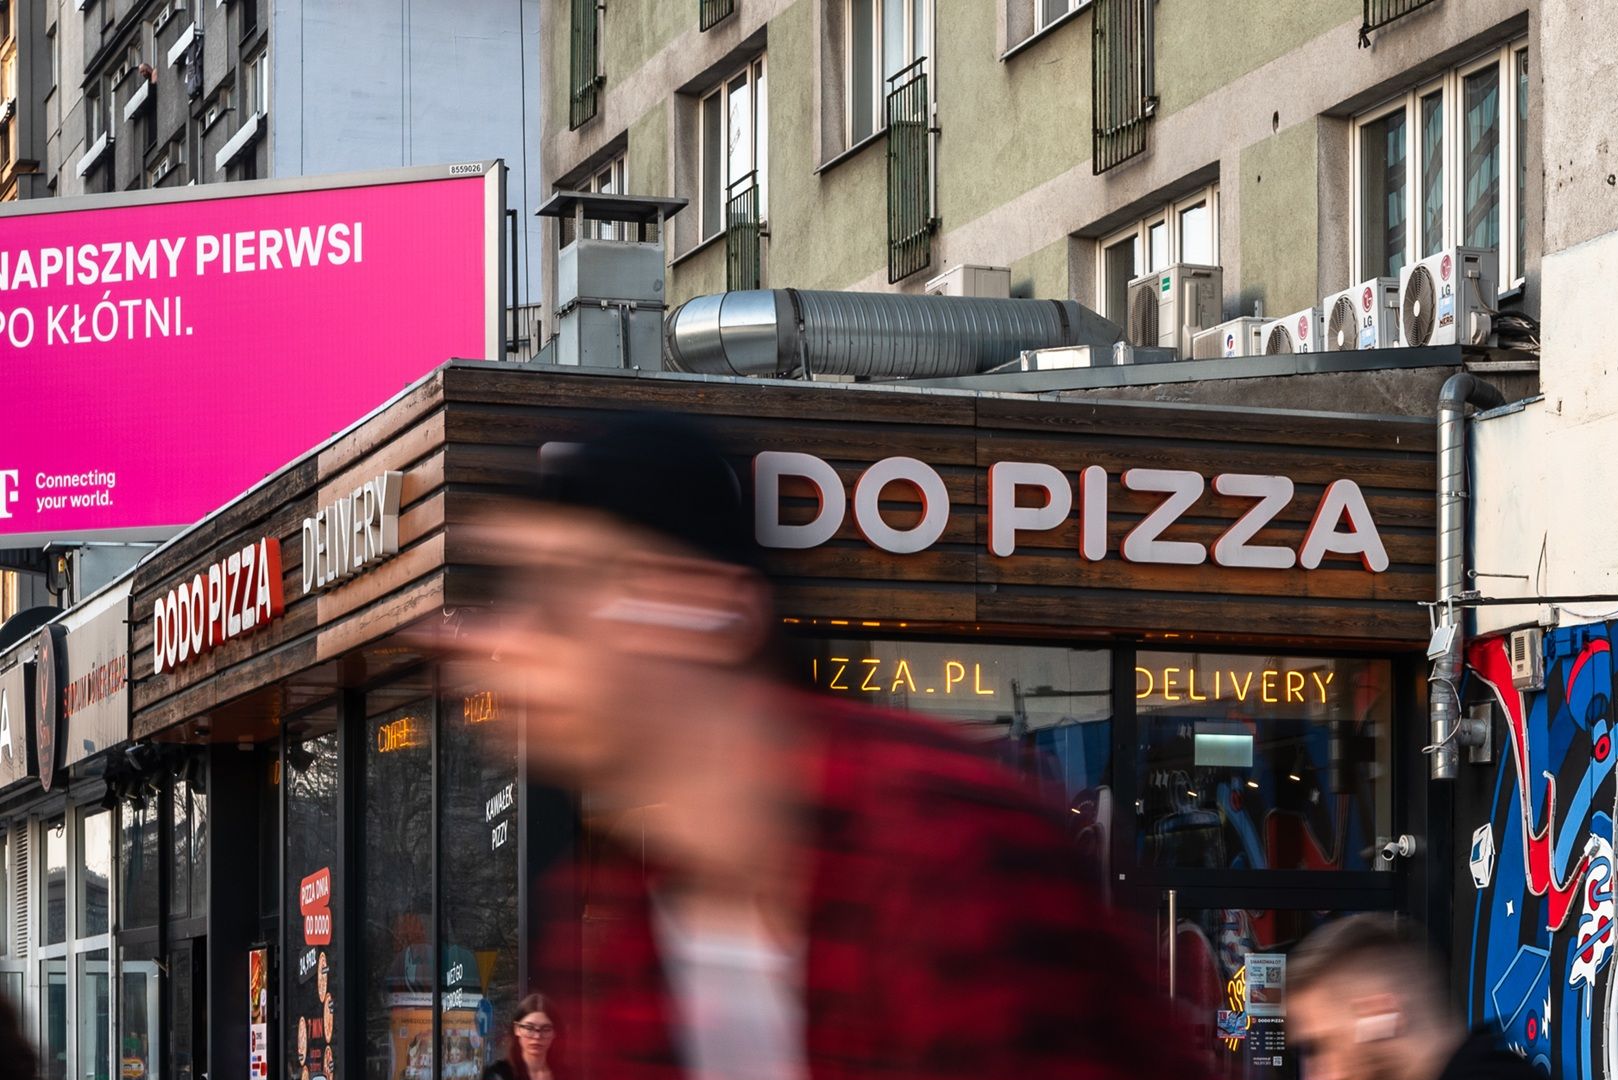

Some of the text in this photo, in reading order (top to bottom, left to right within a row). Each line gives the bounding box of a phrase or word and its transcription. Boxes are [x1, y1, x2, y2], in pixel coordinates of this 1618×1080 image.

[450, 164, 481, 174] 8559026
[0, 222, 363, 291] NAPISZMY PIERWSI
[0, 290, 194, 348] O KŁÓTNI.
[1363, 316, 1373, 328] LG
[35, 469, 116, 489] Connecting
[37, 489, 113, 513] your world.
[987, 460, 1390, 574] PIZZA
[302, 470, 392, 595] DELIVERY
[154, 536, 274, 675] DODO PIZZA
[813, 656, 1334, 703] IZZA.PL DELIVERY
[485, 782, 514, 822] KAWAŁEK
[491, 819, 509, 851] PIZZY
[301, 875, 329, 906] PIZZA DNIA
[306, 915, 329, 935] OD DODO
